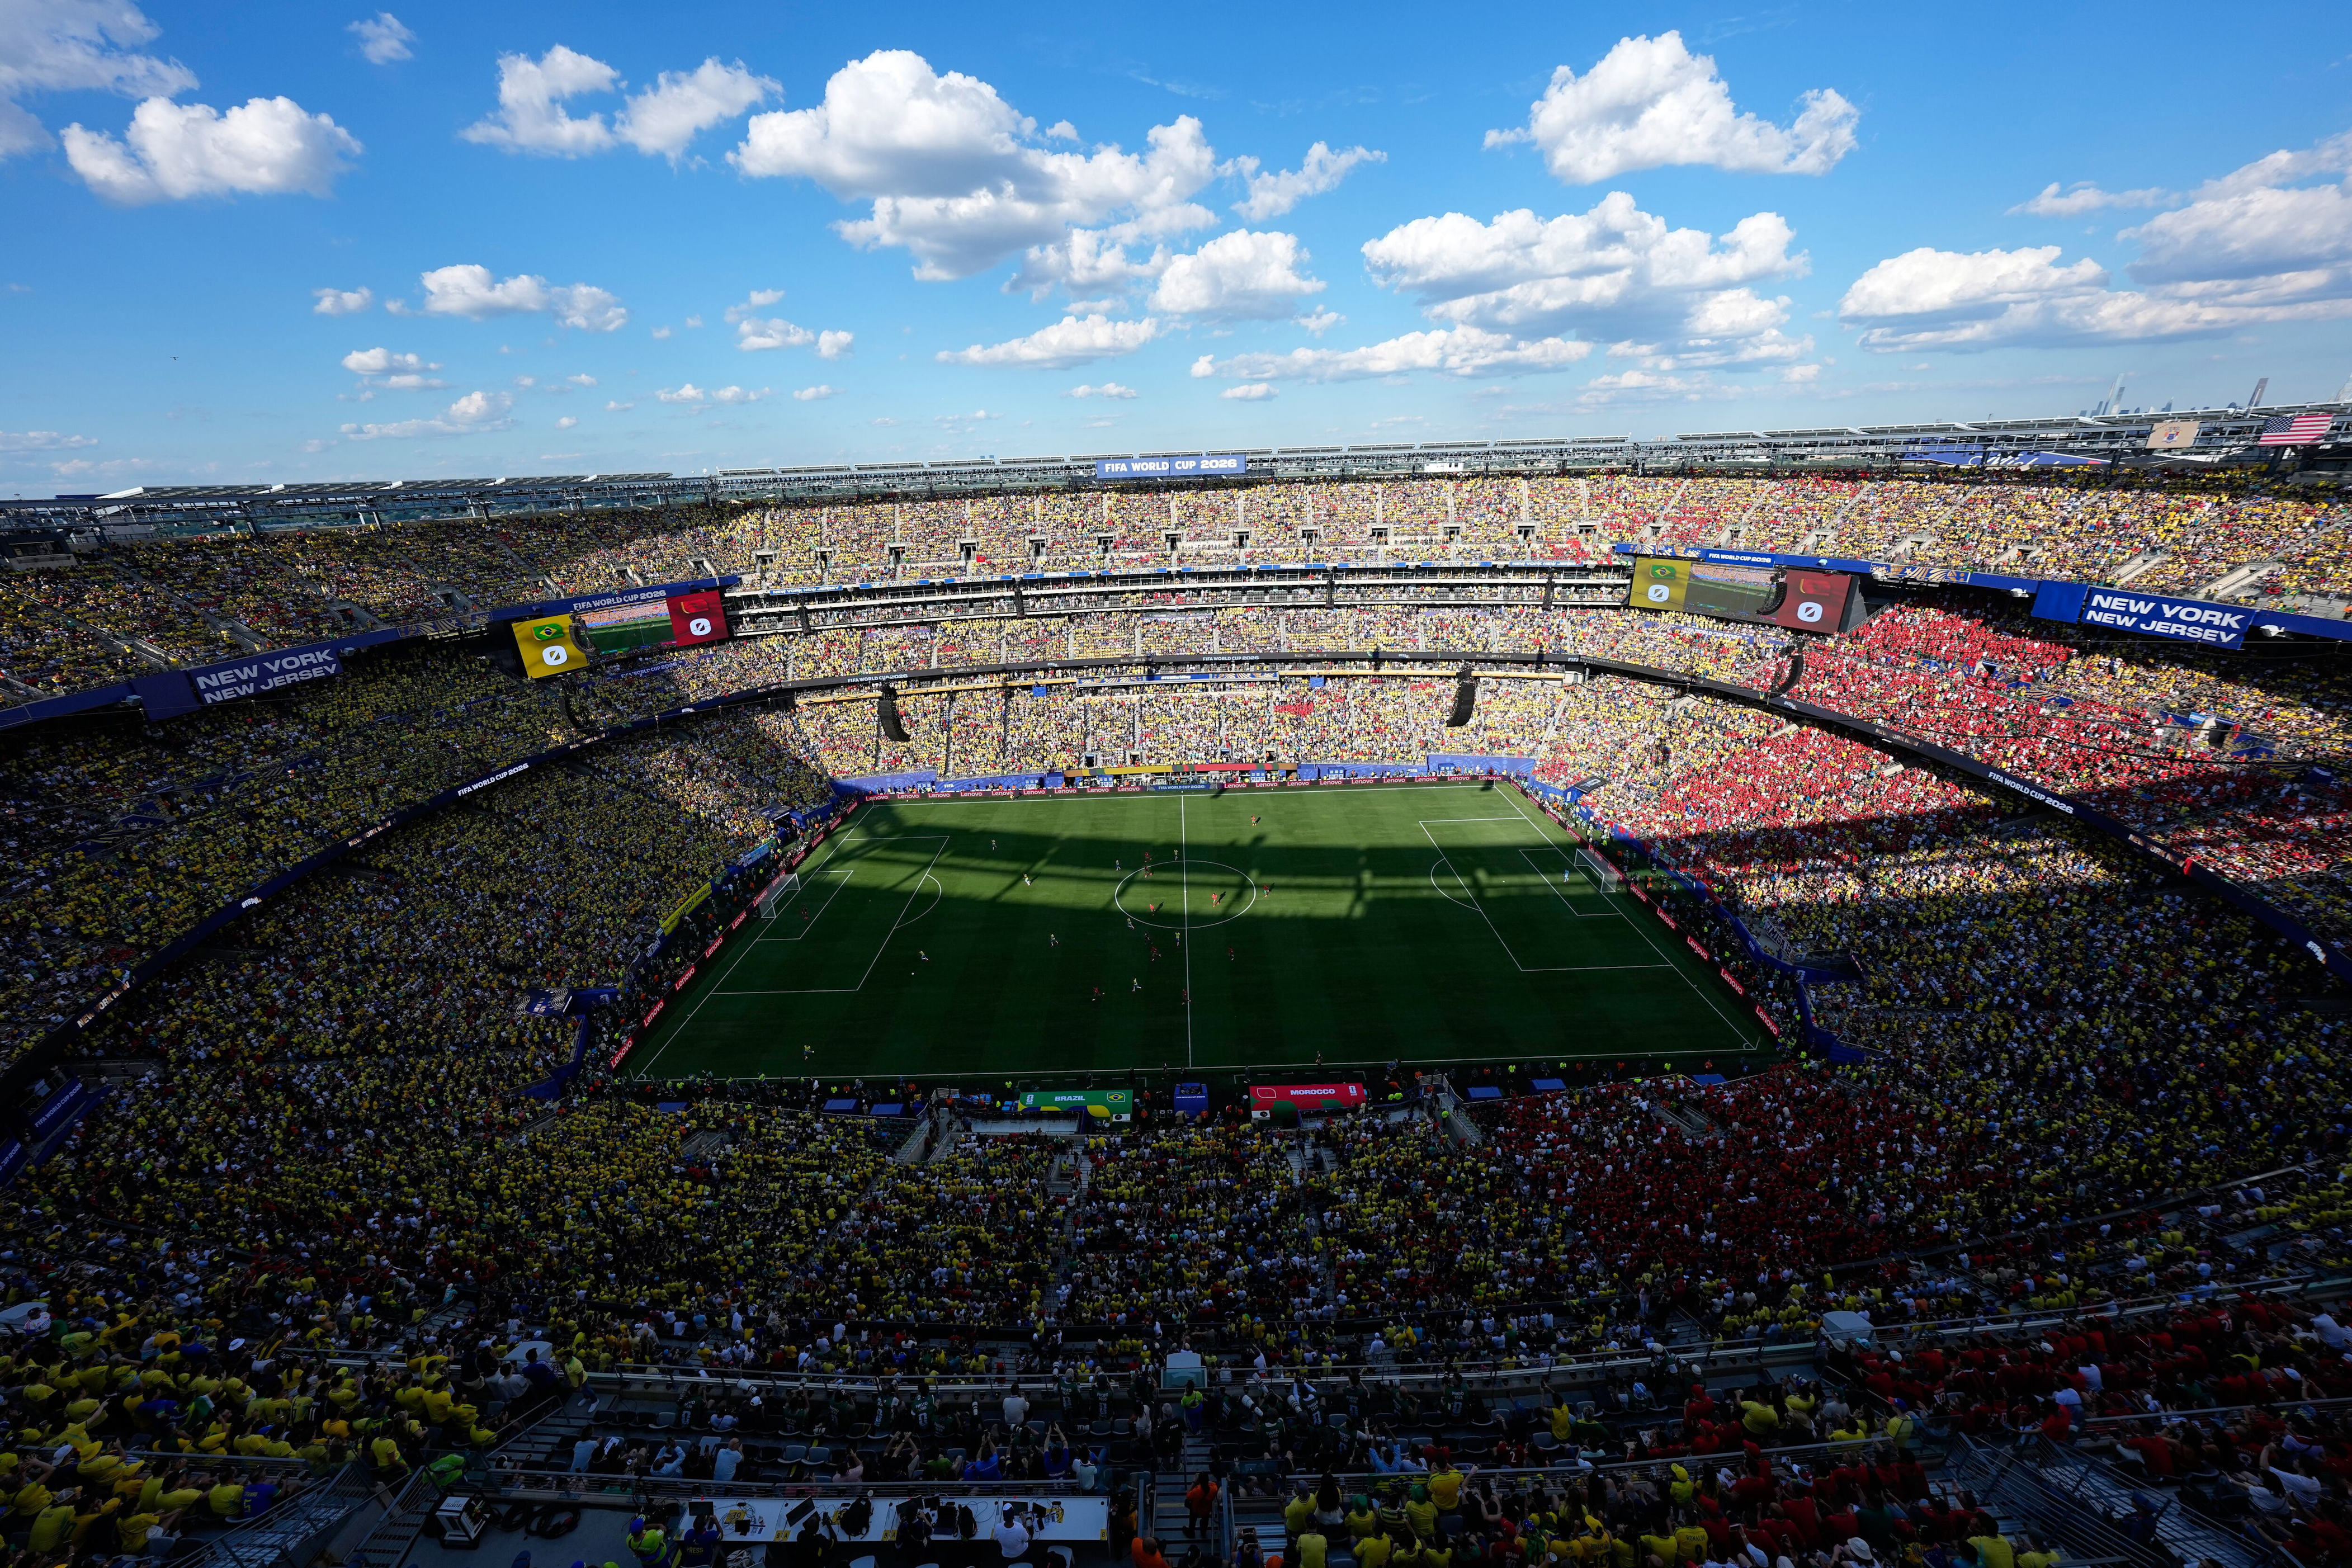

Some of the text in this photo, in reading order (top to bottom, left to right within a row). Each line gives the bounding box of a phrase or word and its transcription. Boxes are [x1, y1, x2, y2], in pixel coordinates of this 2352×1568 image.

[1105, 459, 1238, 473] FIFA WORLD CUP 2026
[573, 590, 667, 611] FIFA WORLD CUP 2026
[2091, 594, 2246, 629] NEW YORK
[2086, 610, 2237, 643] NEW JERSEY
[196, 649, 335, 689] NEW YORK
[204, 663, 337, 704] NEW JERSEY
[457, 763, 530, 796] FIFA WORLD CUP 2026
[1988, 771, 2074, 815] FIFA WORLD CUP 2026
[1546, 810, 1558, 823] Lenovo
[811, 834, 824, 848] Lenovo
[1566, 826, 1580, 842] Lenovo
[792, 851, 805, 866] Lenovo
[679, 887, 711, 918] VERDE AMARELO
[753, 890, 767, 907] Lenovo
[1630, 883, 1647, 902] Lenovo
[1656, 908, 1675, 929] Lenovo
[705, 937, 722, 958] Lenovo
[1687, 936, 1708, 960] Lenovo
[675, 967, 695, 990] Lenovo
[1721, 969, 1742, 994] Lenovo
[644, 1002, 663, 1028] Lenovo
[1756, 1005, 1778, 1035] Lenovo
[611, 1040, 632, 1069] Lenovo
[34, 1083, 83, 1128] FIFA WORLD CUP 2026
[309, 1407, 317, 1421] 11
[1307, 1400, 1319, 1409] PHOTO
[1509, 1451, 1517, 1463] 2
[686, 1546, 704, 1555] PRESS
[1695, 1545, 1703, 1561] 9
